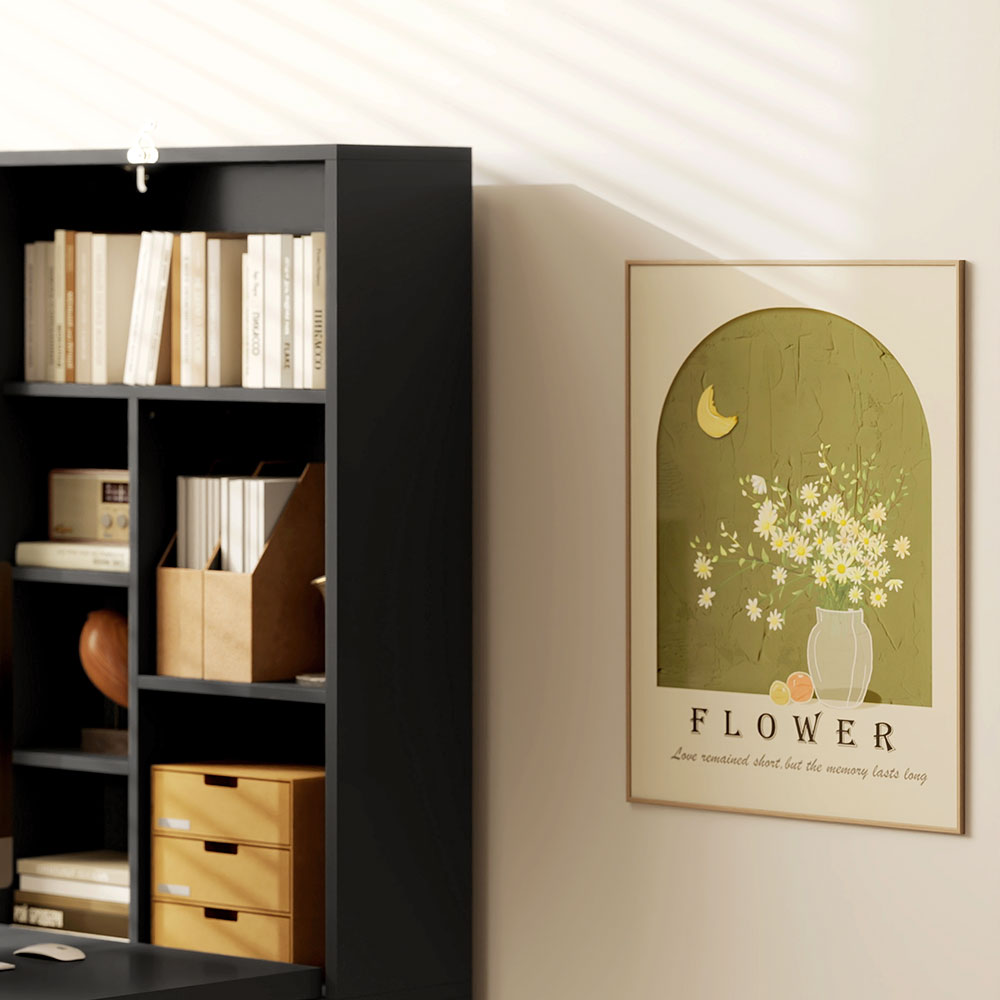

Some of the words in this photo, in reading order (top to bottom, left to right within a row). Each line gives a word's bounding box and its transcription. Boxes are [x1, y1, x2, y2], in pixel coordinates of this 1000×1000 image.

[690, 707, 895, 751] FLOWER
[671, 746, 698, 761] Love
[702, 752, 750, 766] remained
[806, 759, 822, 773] the
[826, 765, 869, 780] memory
[872, 765, 899, 779] lasts
[904, 768, 928, 785] long
